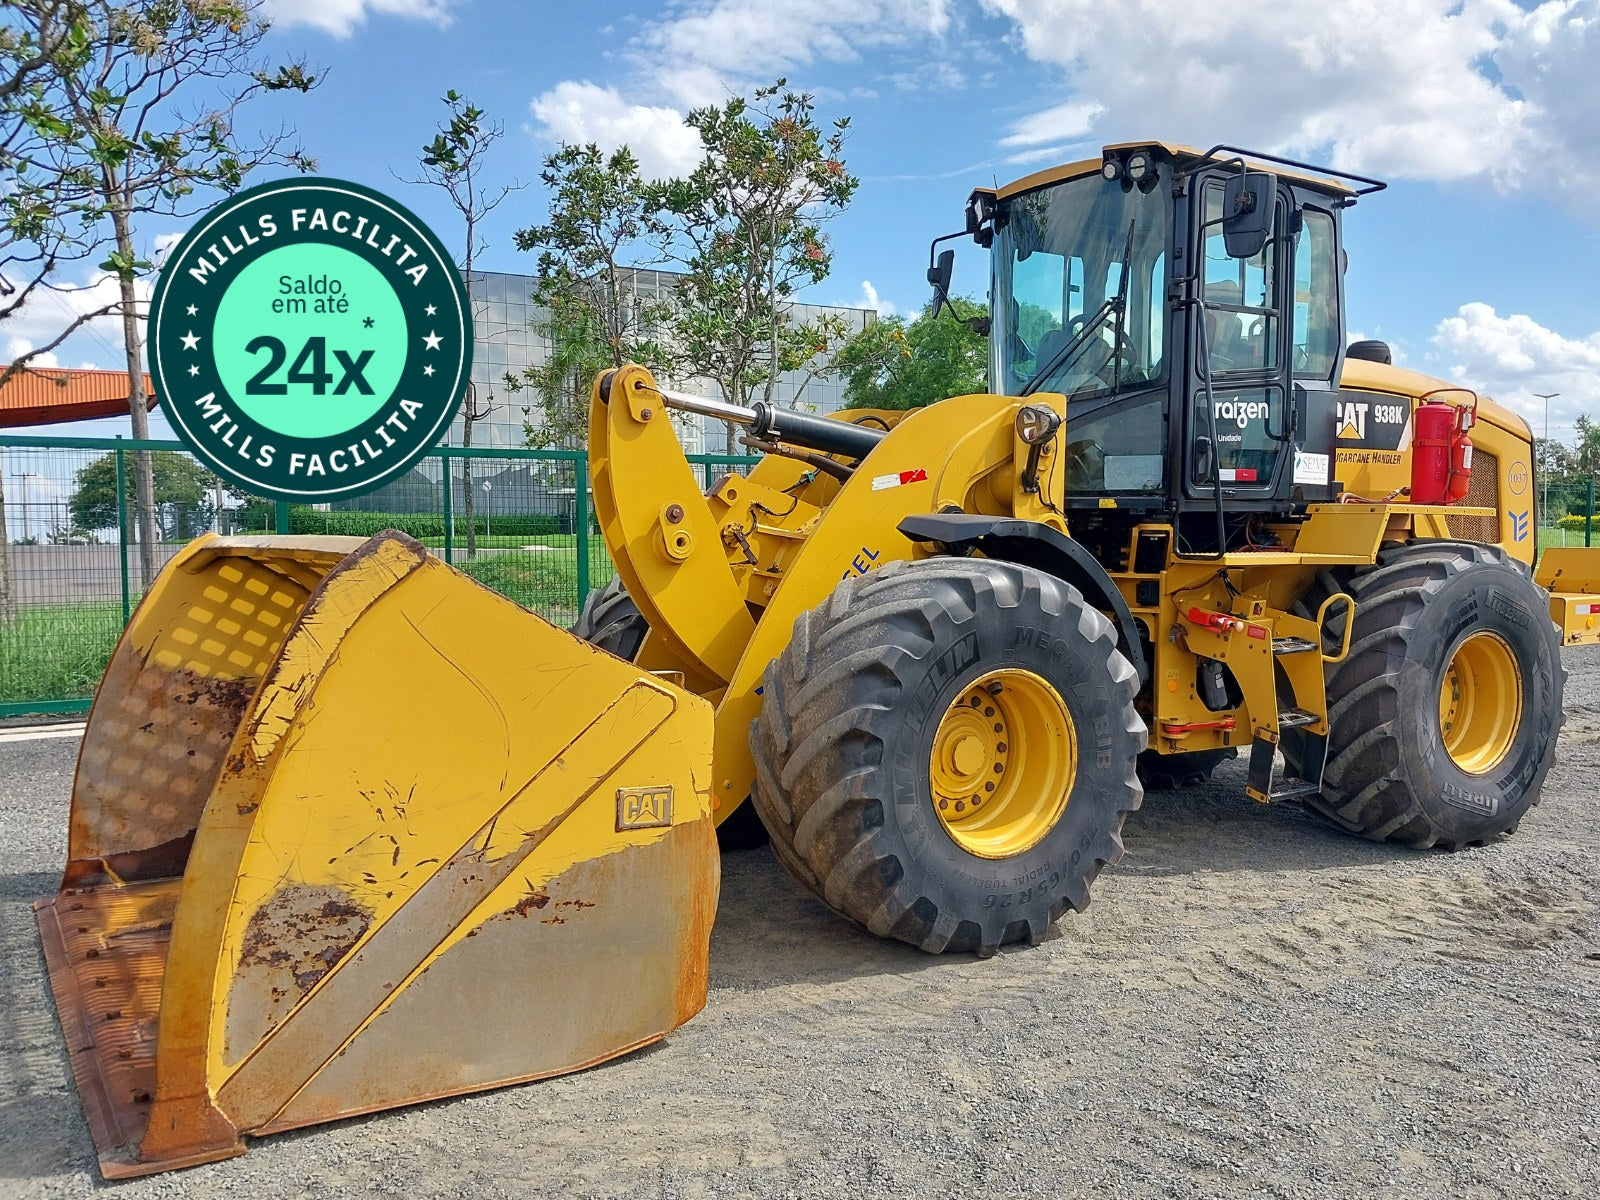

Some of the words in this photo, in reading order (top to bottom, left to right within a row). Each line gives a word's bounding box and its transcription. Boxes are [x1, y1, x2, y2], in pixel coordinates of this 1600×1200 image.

[1374, 404, 1403, 424] 938K
[1217, 433, 1242, 442] Unidade
[1372, 452, 1402, 465] HANDLER
[623, 792, 668, 825] CAT
[1440, 781, 1498, 818] PIRELLI
[1012, 861, 1051, 882] RADIAL
